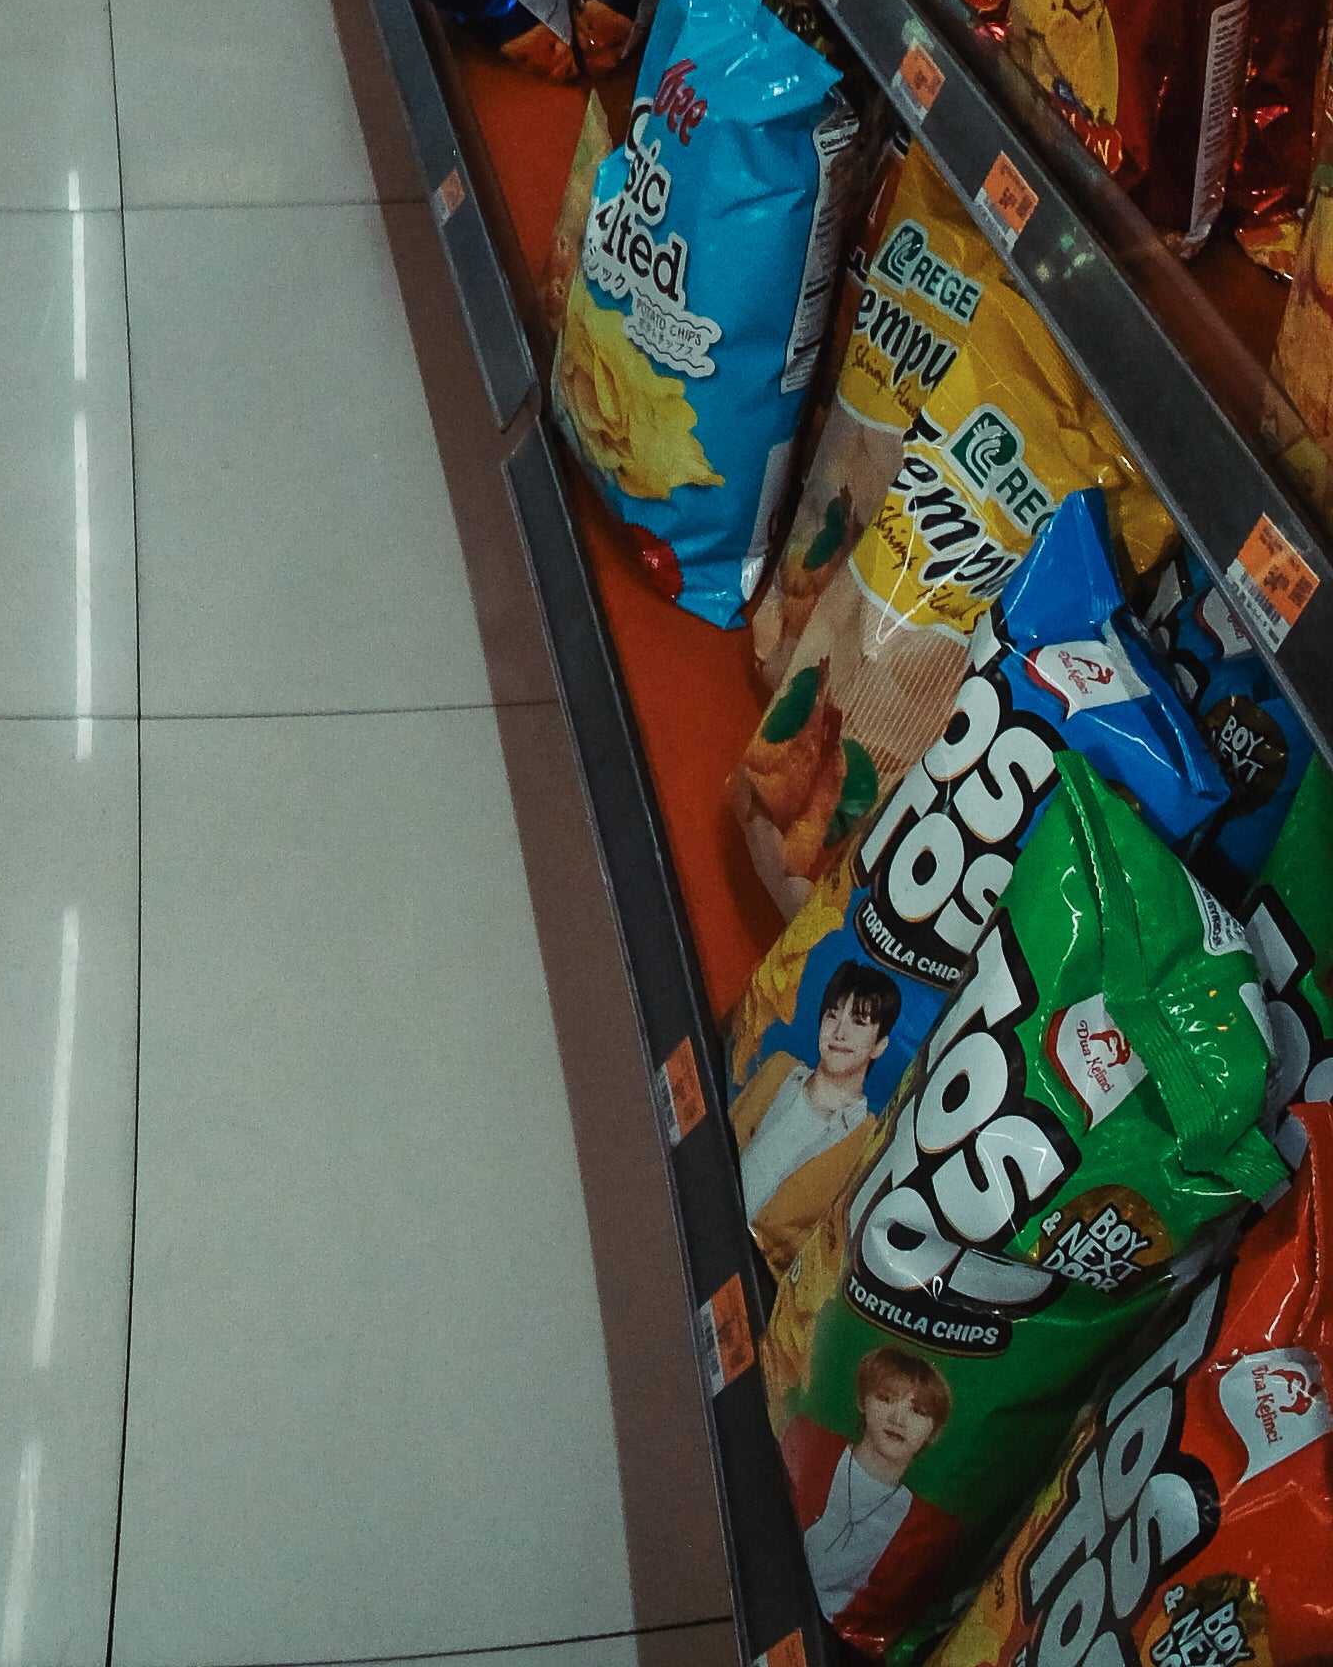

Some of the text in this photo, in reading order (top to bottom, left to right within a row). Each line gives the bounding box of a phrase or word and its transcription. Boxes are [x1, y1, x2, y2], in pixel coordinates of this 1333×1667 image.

[909, 255, 980, 323] REGE
[636, 298, 702, 346] POTATO CHIPS
[854, 289, 957, 388] empu
[1220, 715, 1264, 756] BOY
[860, 901, 961, 981] TORTILLA CHIP
[1077, 1020, 1113, 1096] Dua Kelinci
[1041, 1212, 1061, 1235] &
[1063, 1223, 1140, 1278] NEXT
[1089, 1207, 1143, 1259] BOY
[847, 1275, 999, 1347] TORTILLA CHIPS
[1251, 1394, 1281, 1444] Kelinci
[1164, 1584, 1184, 1609] &
[1203, 1603, 1251, 1664] BOY
